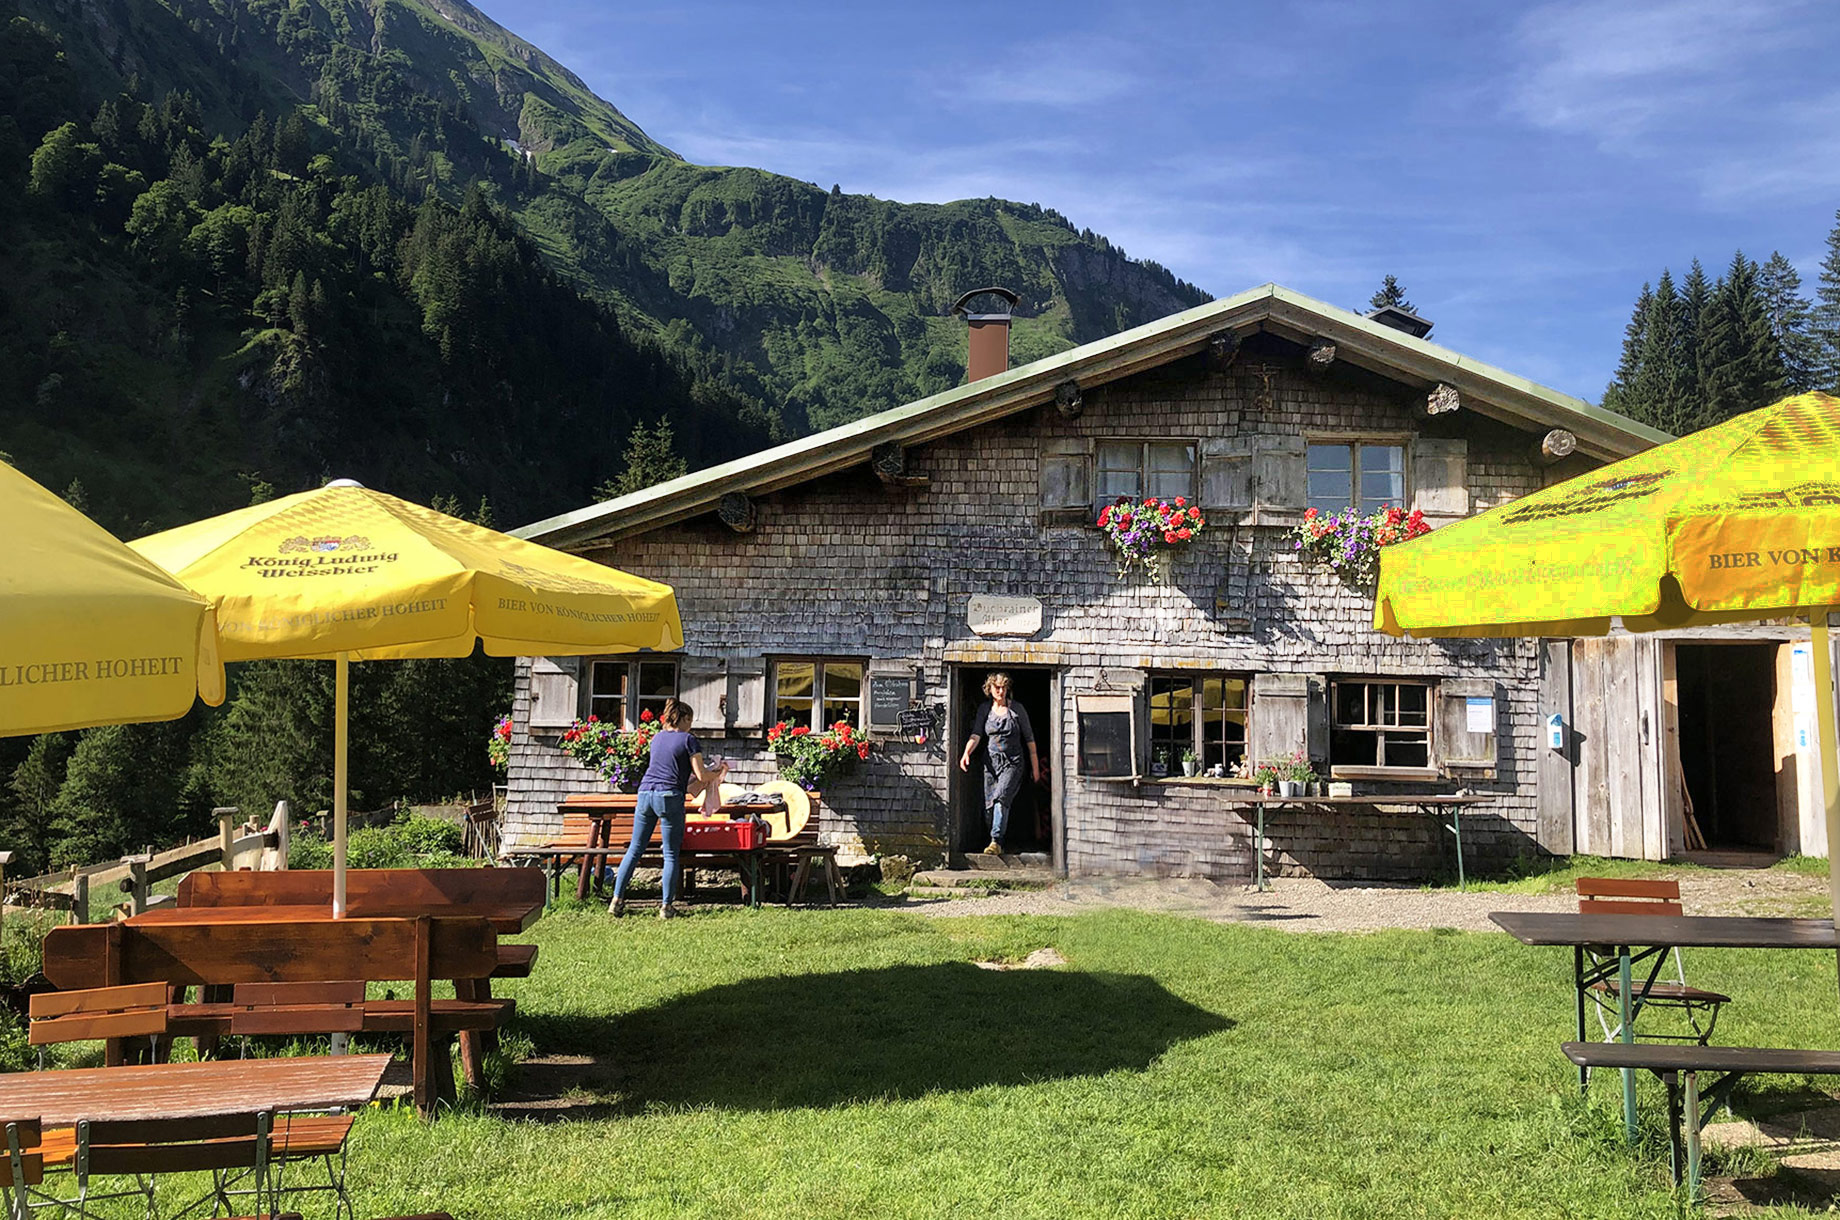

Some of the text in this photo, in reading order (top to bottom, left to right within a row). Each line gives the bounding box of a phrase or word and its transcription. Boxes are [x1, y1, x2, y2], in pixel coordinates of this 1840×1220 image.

[240, 552, 399, 570] König Ludwig
[1709, 552, 1761, 569] BIER
[1768, 548, 1820, 565] VON
[257, 565, 379, 578] Weissbier
[383, 598, 447, 617] HOHEIT
[498, 597, 527, 612] BIER
[530, 601, 554, 615] VON
[627, 612, 660, 622] HOHEIT
[96, 656, 183, 679] HOHEIT
